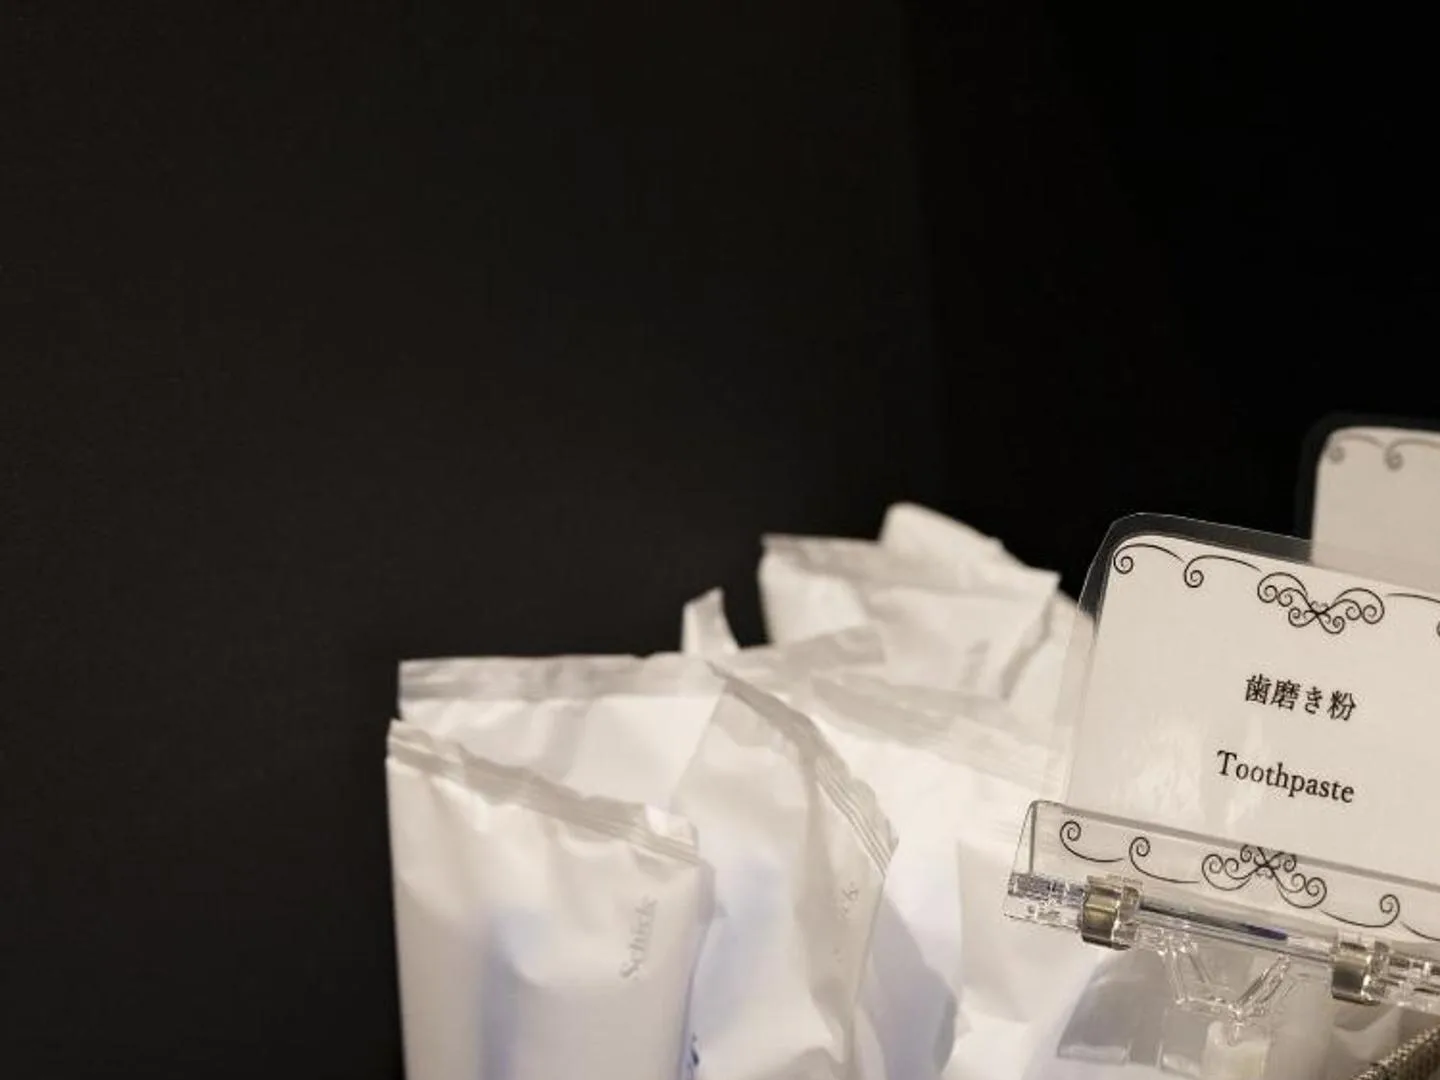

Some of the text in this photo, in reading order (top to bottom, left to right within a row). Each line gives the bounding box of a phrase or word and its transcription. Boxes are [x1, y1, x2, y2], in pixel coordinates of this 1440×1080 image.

[1244, 673, 1357, 722] 歯磨き粉
[1216, 749, 1356, 804] Toothpaste
